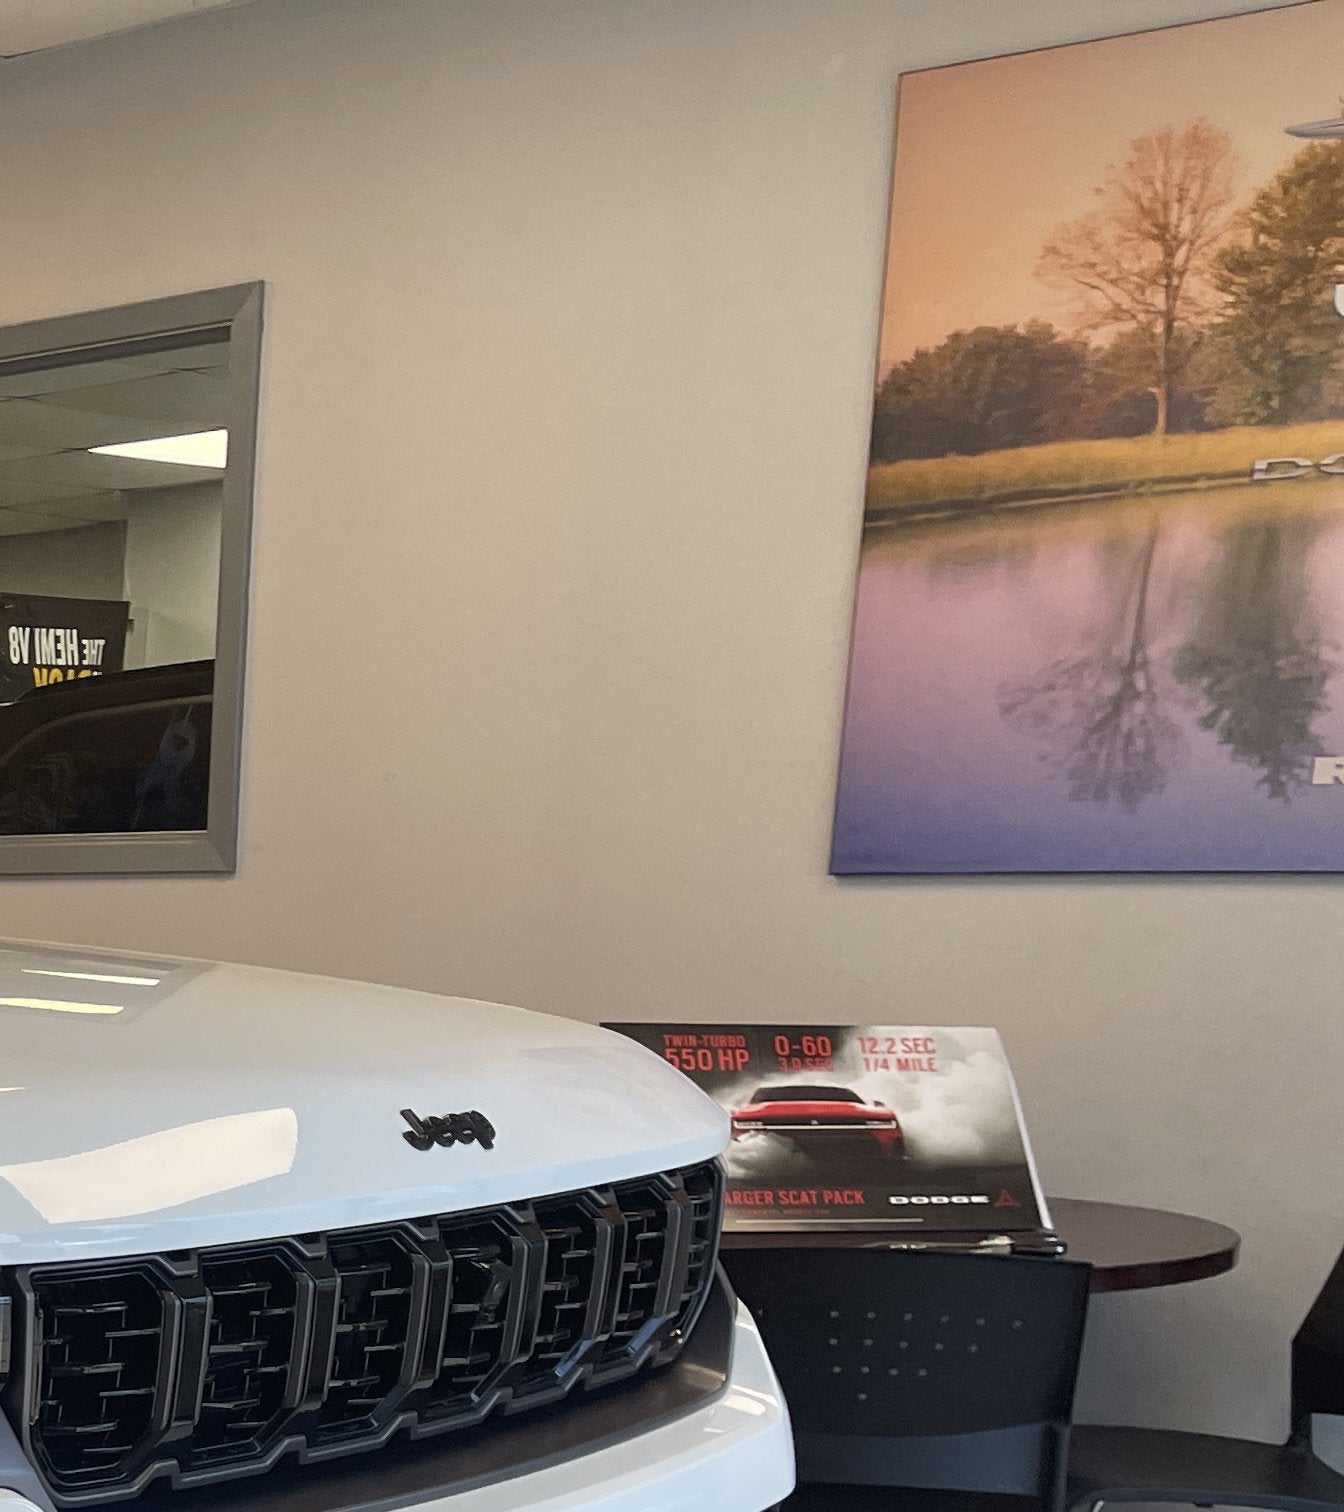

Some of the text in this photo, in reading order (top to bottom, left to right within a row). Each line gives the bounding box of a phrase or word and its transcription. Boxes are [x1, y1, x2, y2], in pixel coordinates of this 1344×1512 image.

[664, 1034, 746, 1048] TWIN-TURBO
[774, 1034, 833, 1057] 0-60
[857, 1037, 937, 1055] 12.2 SEC
[665, 1049, 750, 1072] 550 HP
[863, 1056, 938, 1073] 1/4 MILE
[399, 1108, 496, 1151] Jeep
[778, 1190, 818, 1205] SCAT
[822, 1190, 866, 1205] PACK
[888, 1195, 990, 1205] DODGE
